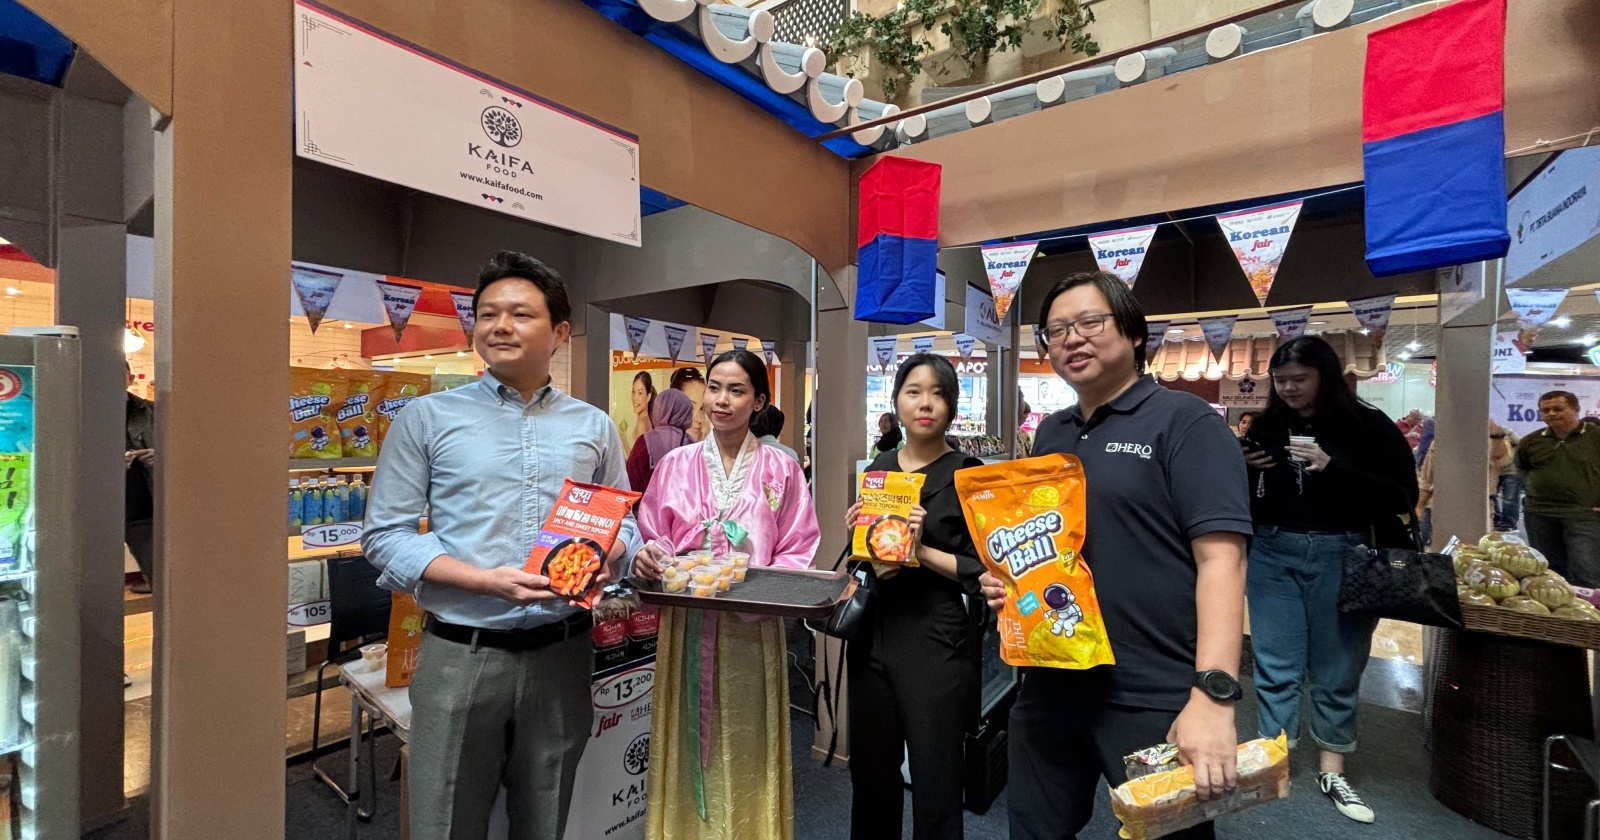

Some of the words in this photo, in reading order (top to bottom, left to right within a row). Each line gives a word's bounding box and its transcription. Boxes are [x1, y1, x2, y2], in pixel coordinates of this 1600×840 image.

[468, 142, 534, 175] KAIFA
[486, 163, 517, 178] FOOD
[459, 171, 543, 201] www.kaifafood.com
[1230, 225, 1290, 242] Korean
[1097, 246, 1145, 259] Korean
[1250, 239, 1273, 252] fair
[987, 259, 1027, 270] Korean
[1113, 258, 1131, 269] fair
[1000, 270, 1015, 279] fair
[383, 294, 415, 305] Korean
[457, 303, 473, 312] Kore
[1355, 306, 1391, 316] Korean
[1275, 318, 1307, 327] Korean
[290, 395, 330, 410] heese
[294, 404, 321, 421] Ball
[337, 404, 364, 421] Ball
[1507, 404, 1544, 422] Kor
[1117, 443, 1152, 455] HERO
[972, 490, 995, 500] SAMJIN
[987, 512, 1061, 562] Cheese
[1007, 534, 1055, 575] Ball
[595, 713, 622, 738] fair
[612, 779, 645, 806] KAI
[627, 793, 647, 808] FOO
[604, 807, 647, 836] www.kaifa
